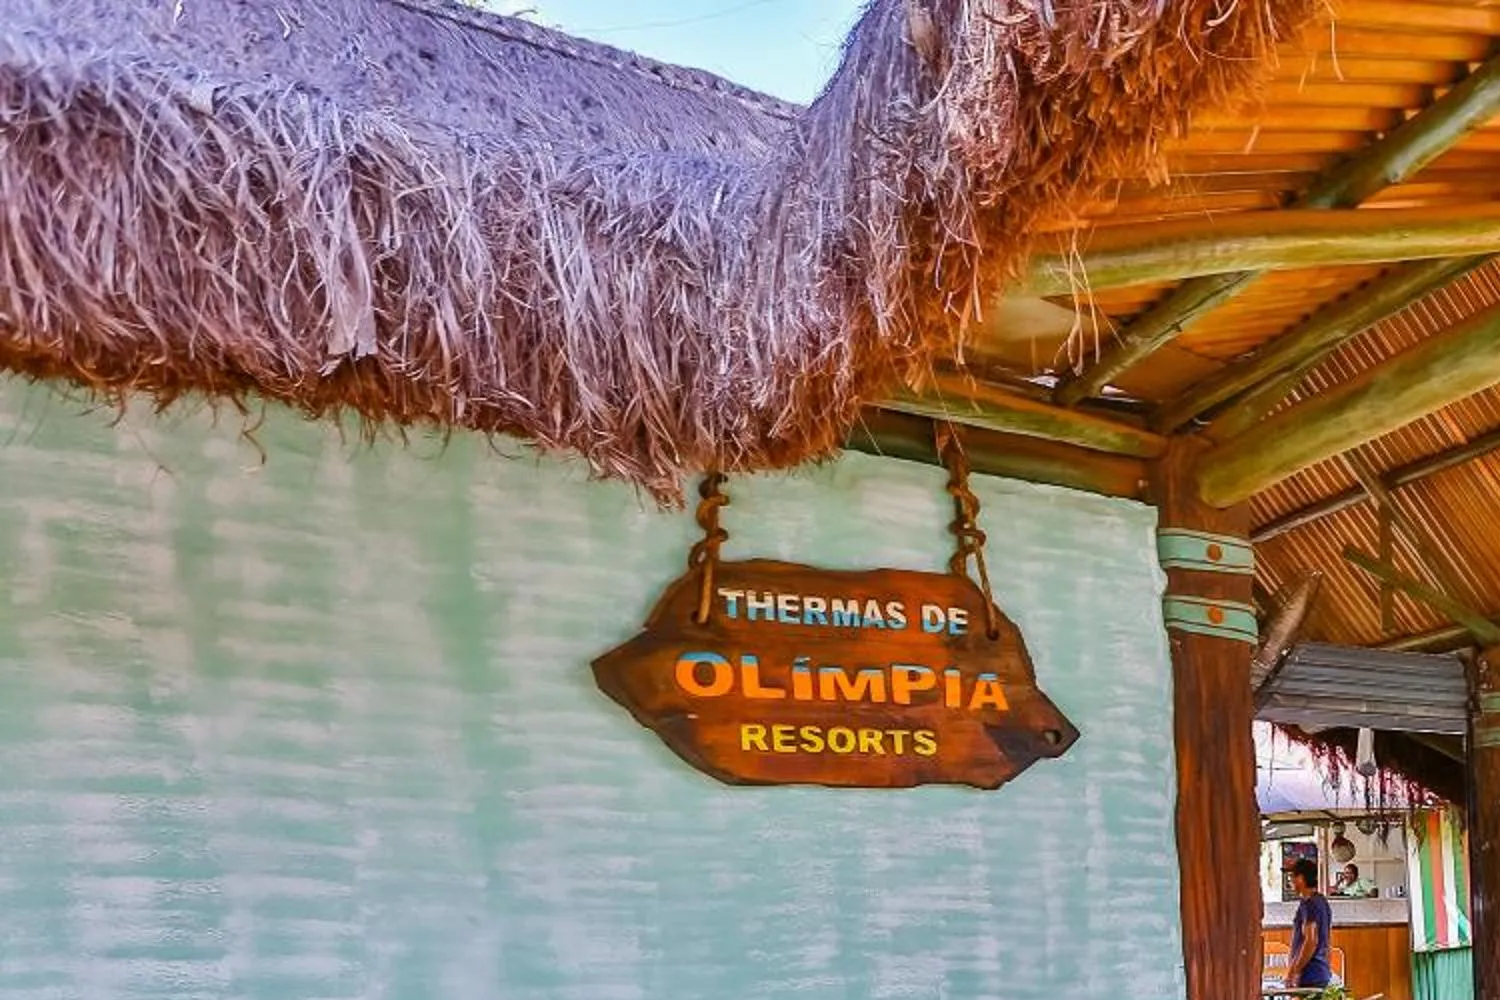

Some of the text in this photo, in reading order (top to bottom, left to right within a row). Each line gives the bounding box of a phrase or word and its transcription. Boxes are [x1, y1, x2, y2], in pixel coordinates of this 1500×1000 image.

[718, 587, 969, 635] THERMAS DE
[675, 651, 1010, 711] OLÍMPIA
[740, 723, 938, 756] RESORTS
